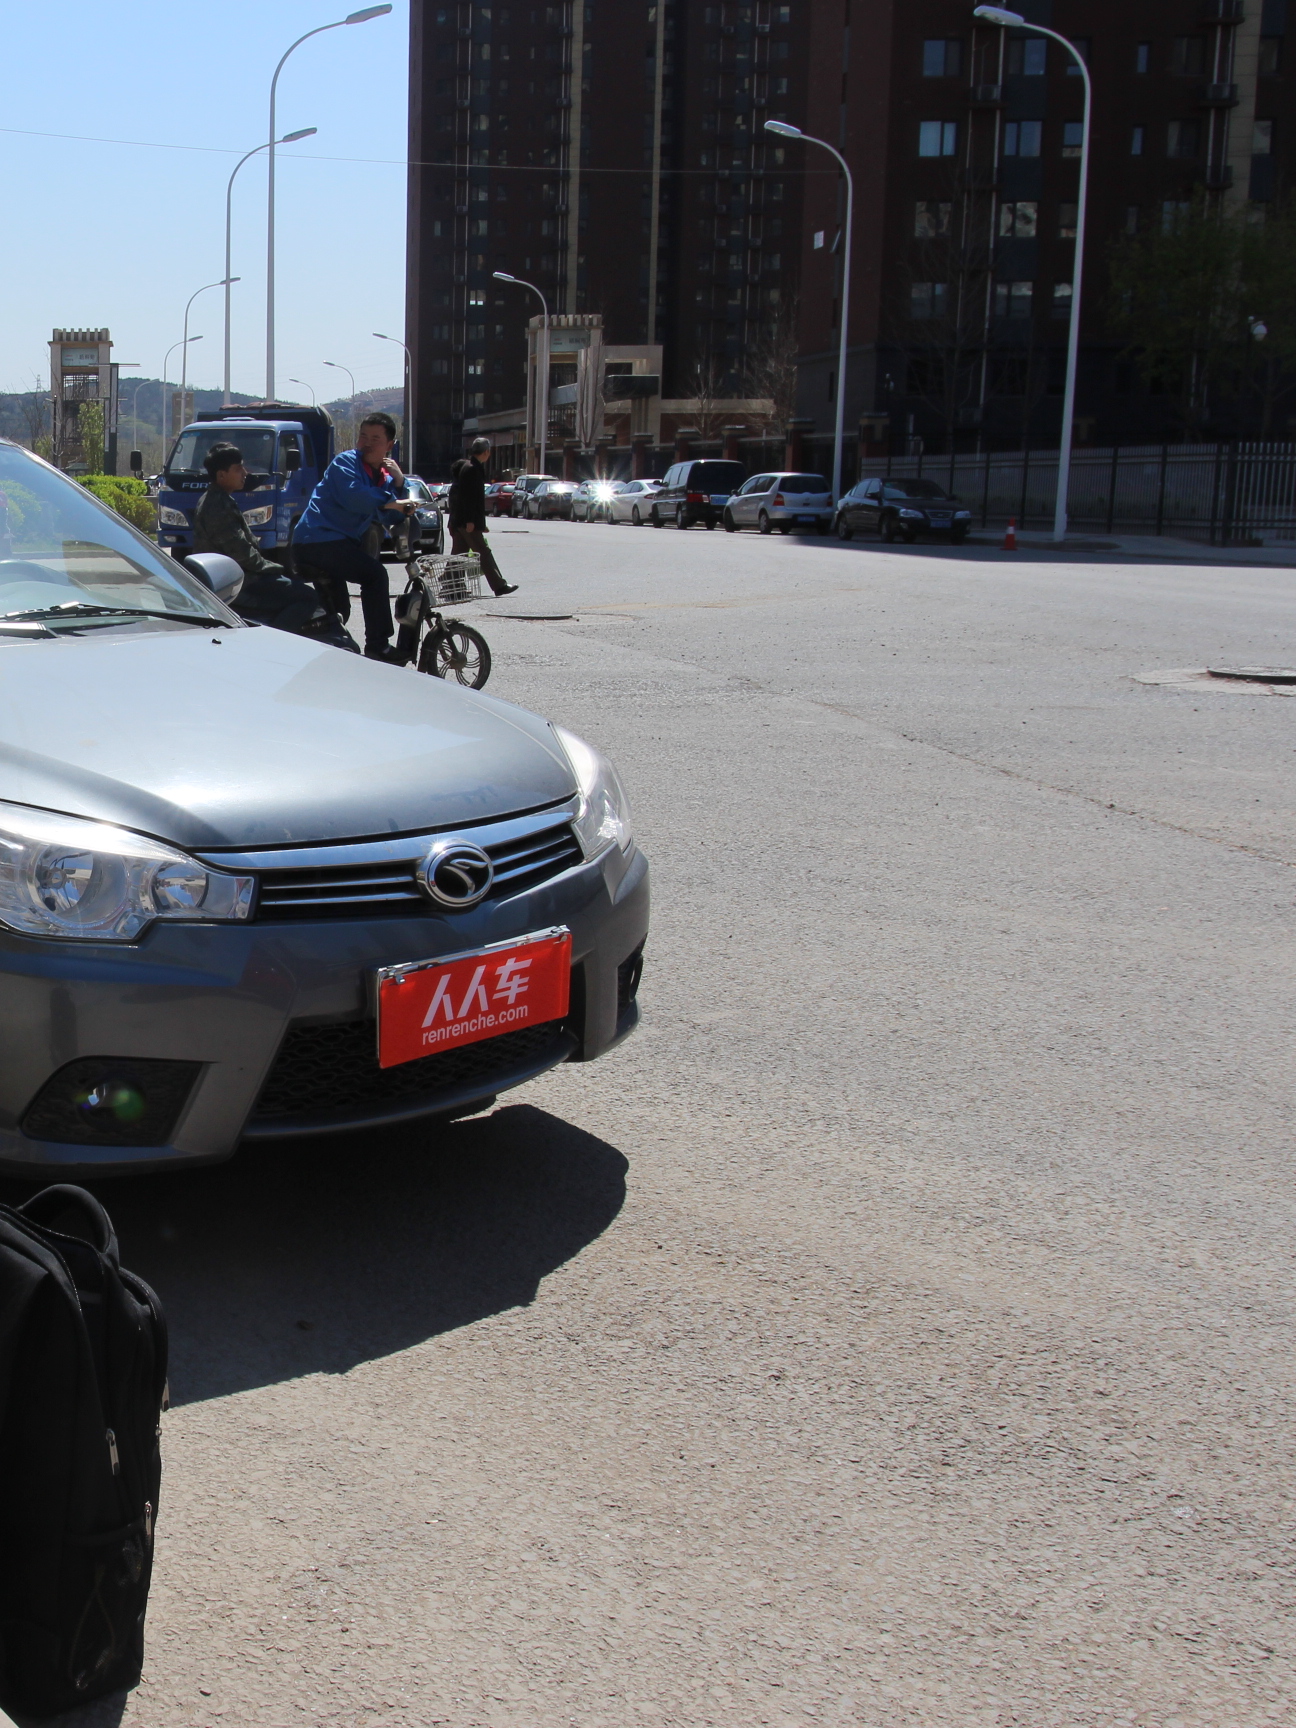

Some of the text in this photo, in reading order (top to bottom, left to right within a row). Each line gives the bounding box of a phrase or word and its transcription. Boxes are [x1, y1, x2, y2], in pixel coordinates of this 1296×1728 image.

[421, 957, 533, 1028] 人人车
[422, 1004, 529, 1045] renrenche.com
